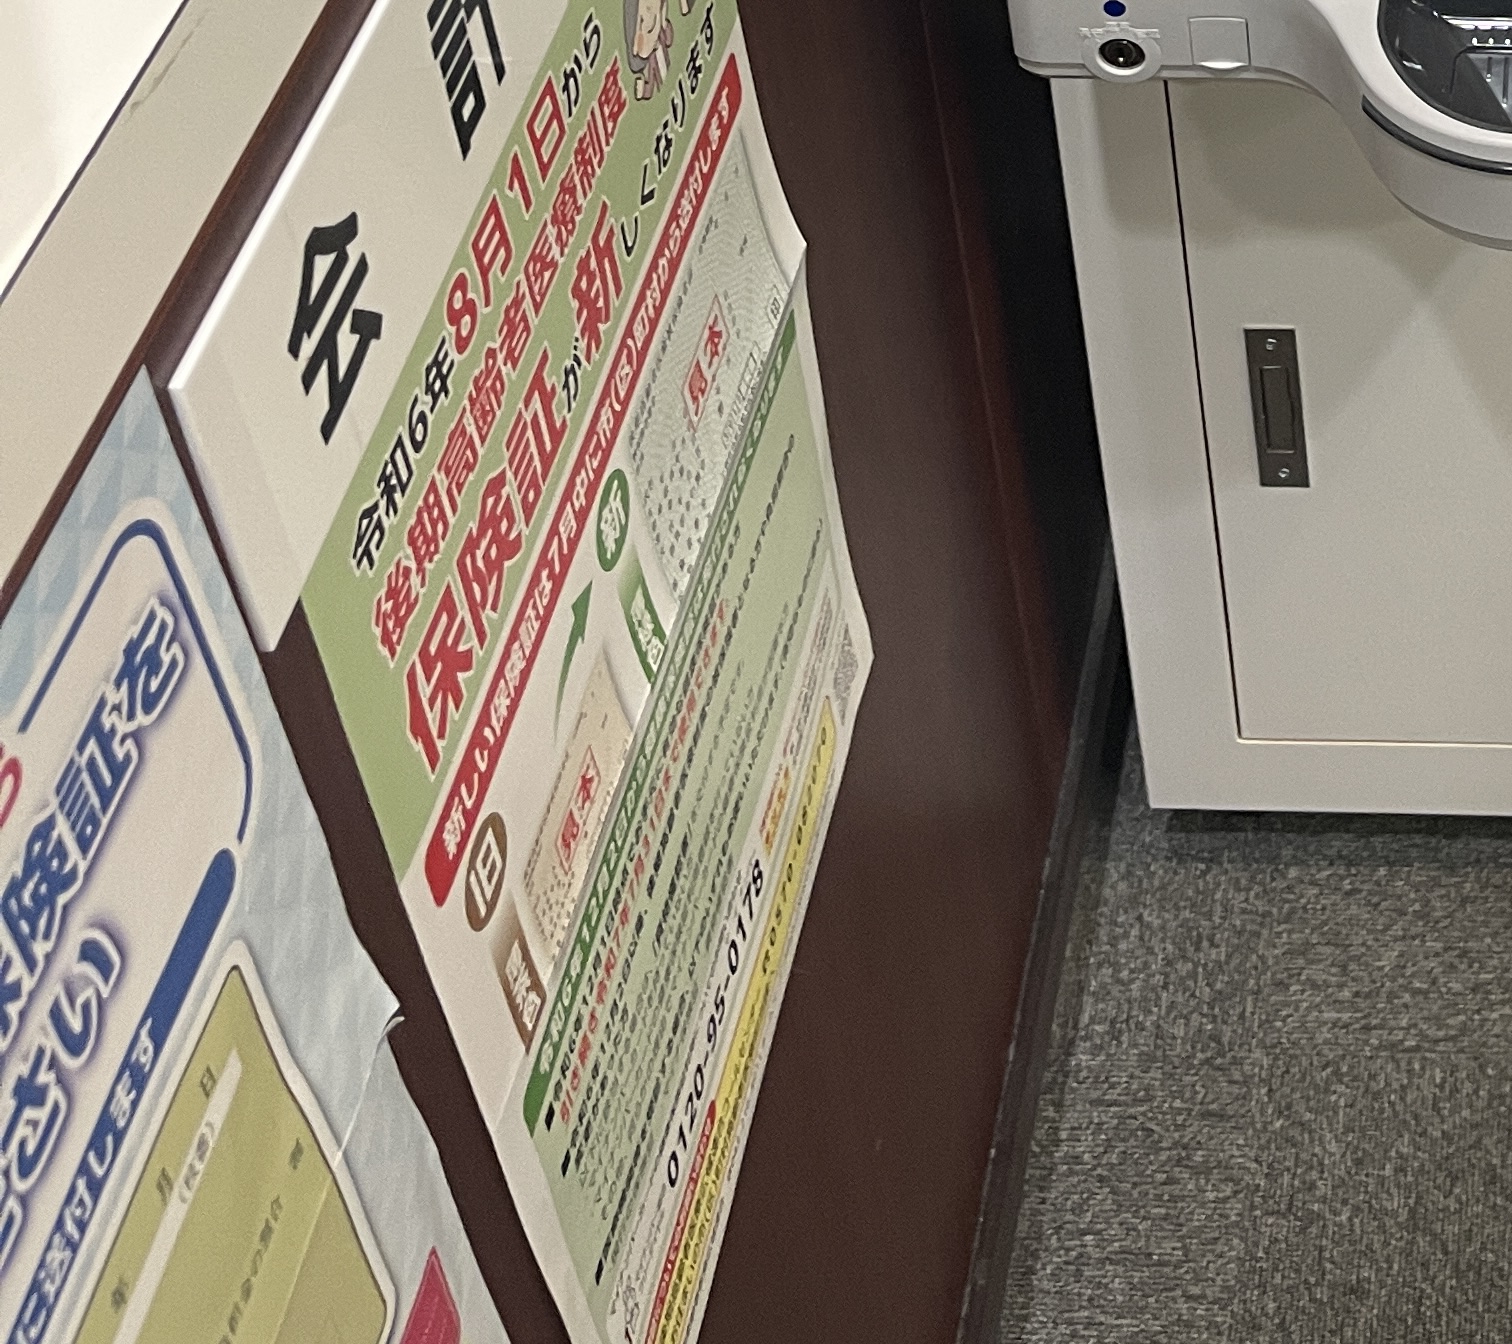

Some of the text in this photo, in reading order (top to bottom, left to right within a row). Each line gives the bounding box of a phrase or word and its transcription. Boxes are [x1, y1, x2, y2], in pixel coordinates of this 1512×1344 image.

[368, 51, 631, 669] 後期高齢者医療制度
[598, 475, 628, 566] 新
[467, 820, 505, 919] 旧
[665, 855, 764, 1192] 0120-95-0178
